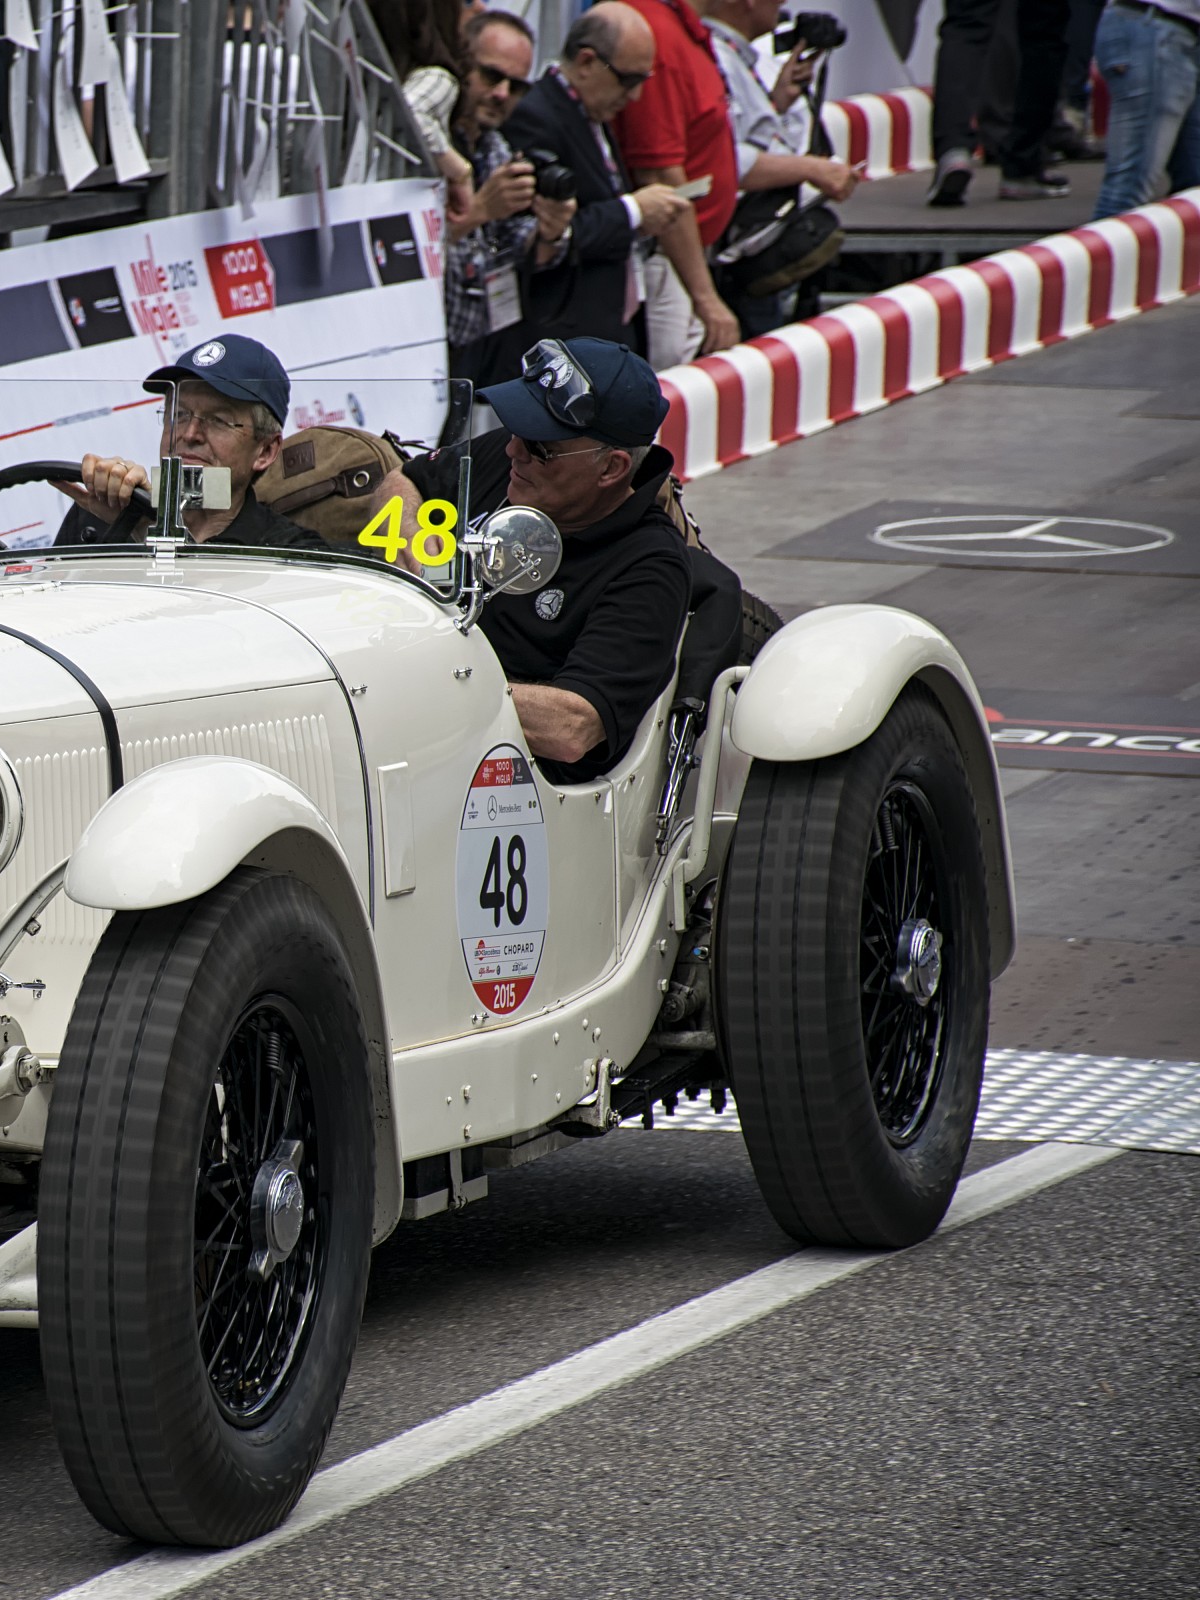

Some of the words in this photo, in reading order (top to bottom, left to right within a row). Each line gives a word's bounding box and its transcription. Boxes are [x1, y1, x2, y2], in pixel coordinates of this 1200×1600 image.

[168, 260, 198, 290] 2015
[223, 247, 257, 276] 1000
[229, 281, 268, 310] MIGLIA
[358, 495, 458, 567] 48
[496, 761, 510, 771] 1000
[479, 835, 528, 928] 48
[503, 942, 535, 956] CHOPARD
[493, 983, 517, 1009] 2015
